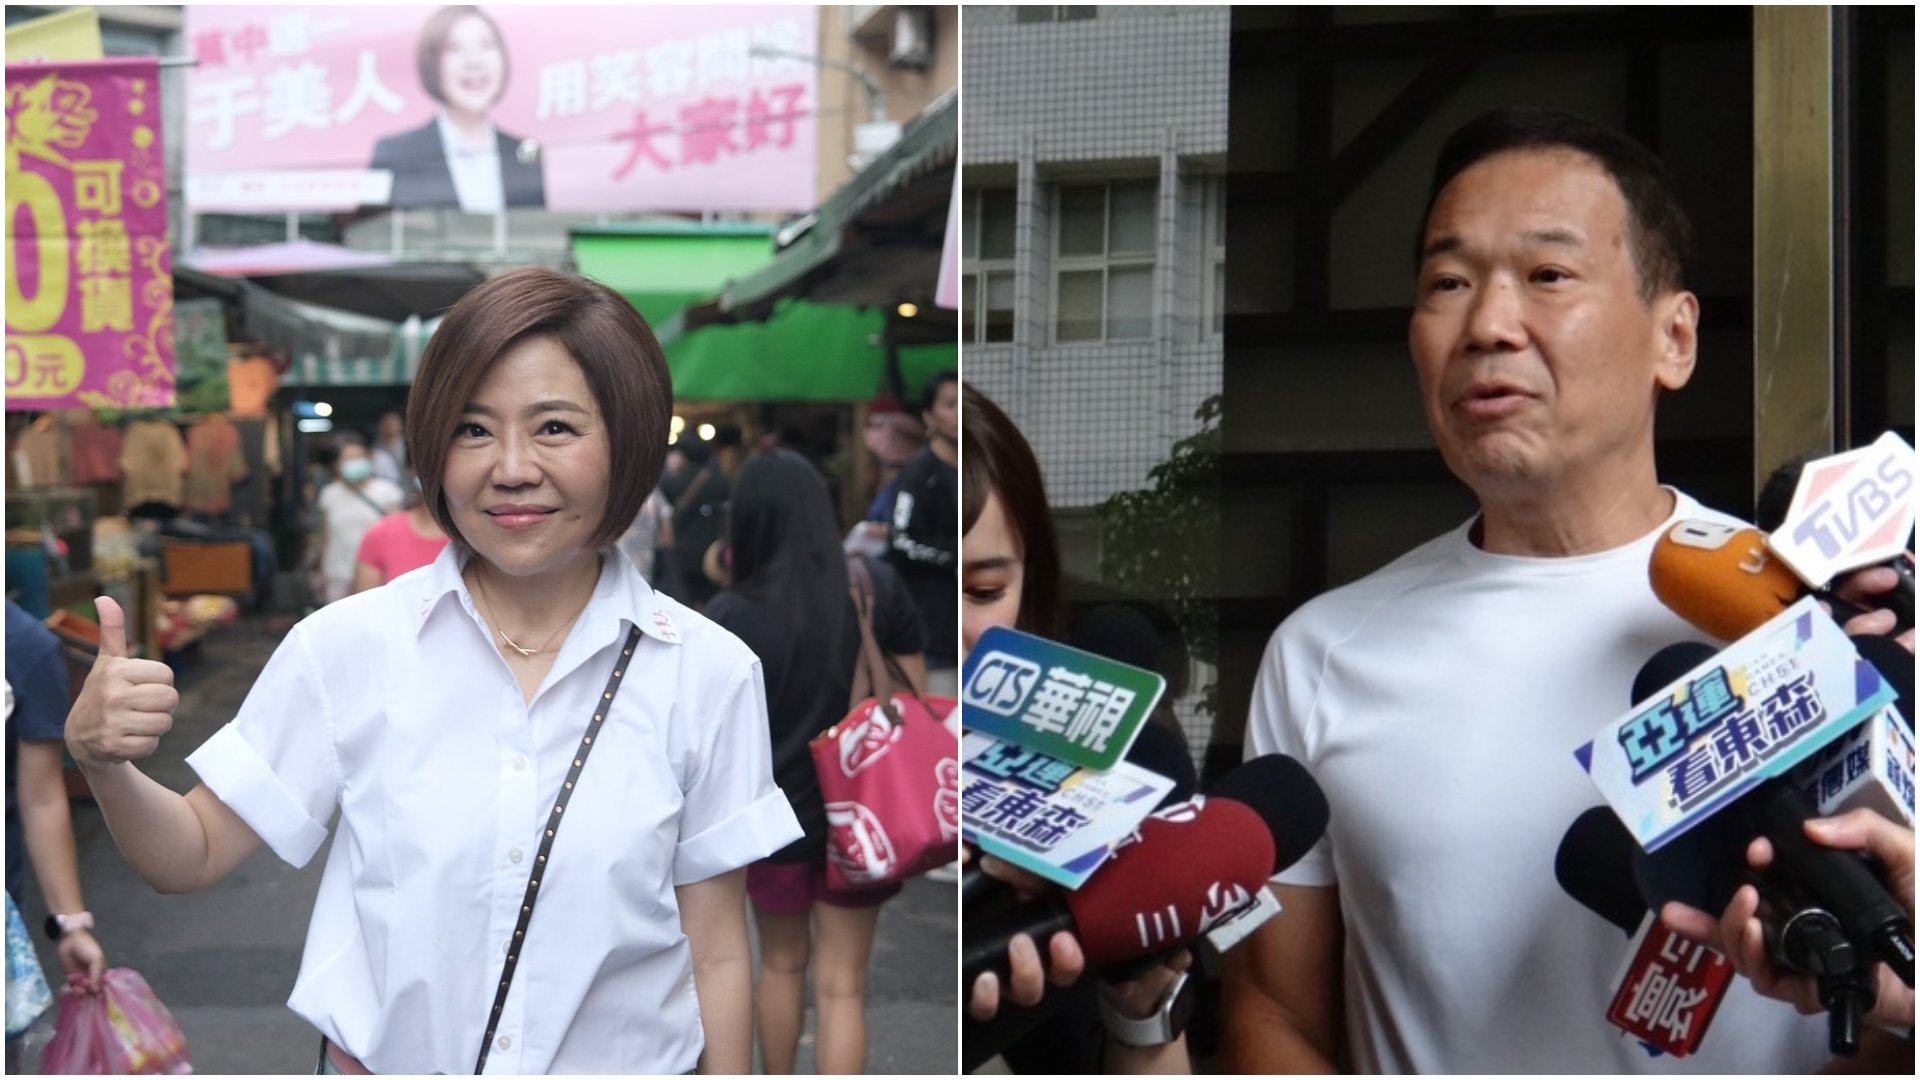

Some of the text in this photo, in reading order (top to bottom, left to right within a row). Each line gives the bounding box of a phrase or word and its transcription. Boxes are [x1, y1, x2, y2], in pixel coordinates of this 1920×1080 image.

[192, 50, 404, 149] 于美人
[608, 85, 809, 181] 大家好
[74, 160, 133, 332] 可換貨
[1792, 454, 1913, 561] TVBS
[969, 658, 1034, 706] CTS
[1021, 667, 1136, 752] 華視
[1620, 666, 1742, 781] 亞運
[1666, 675, 1820, 803] 看東森
